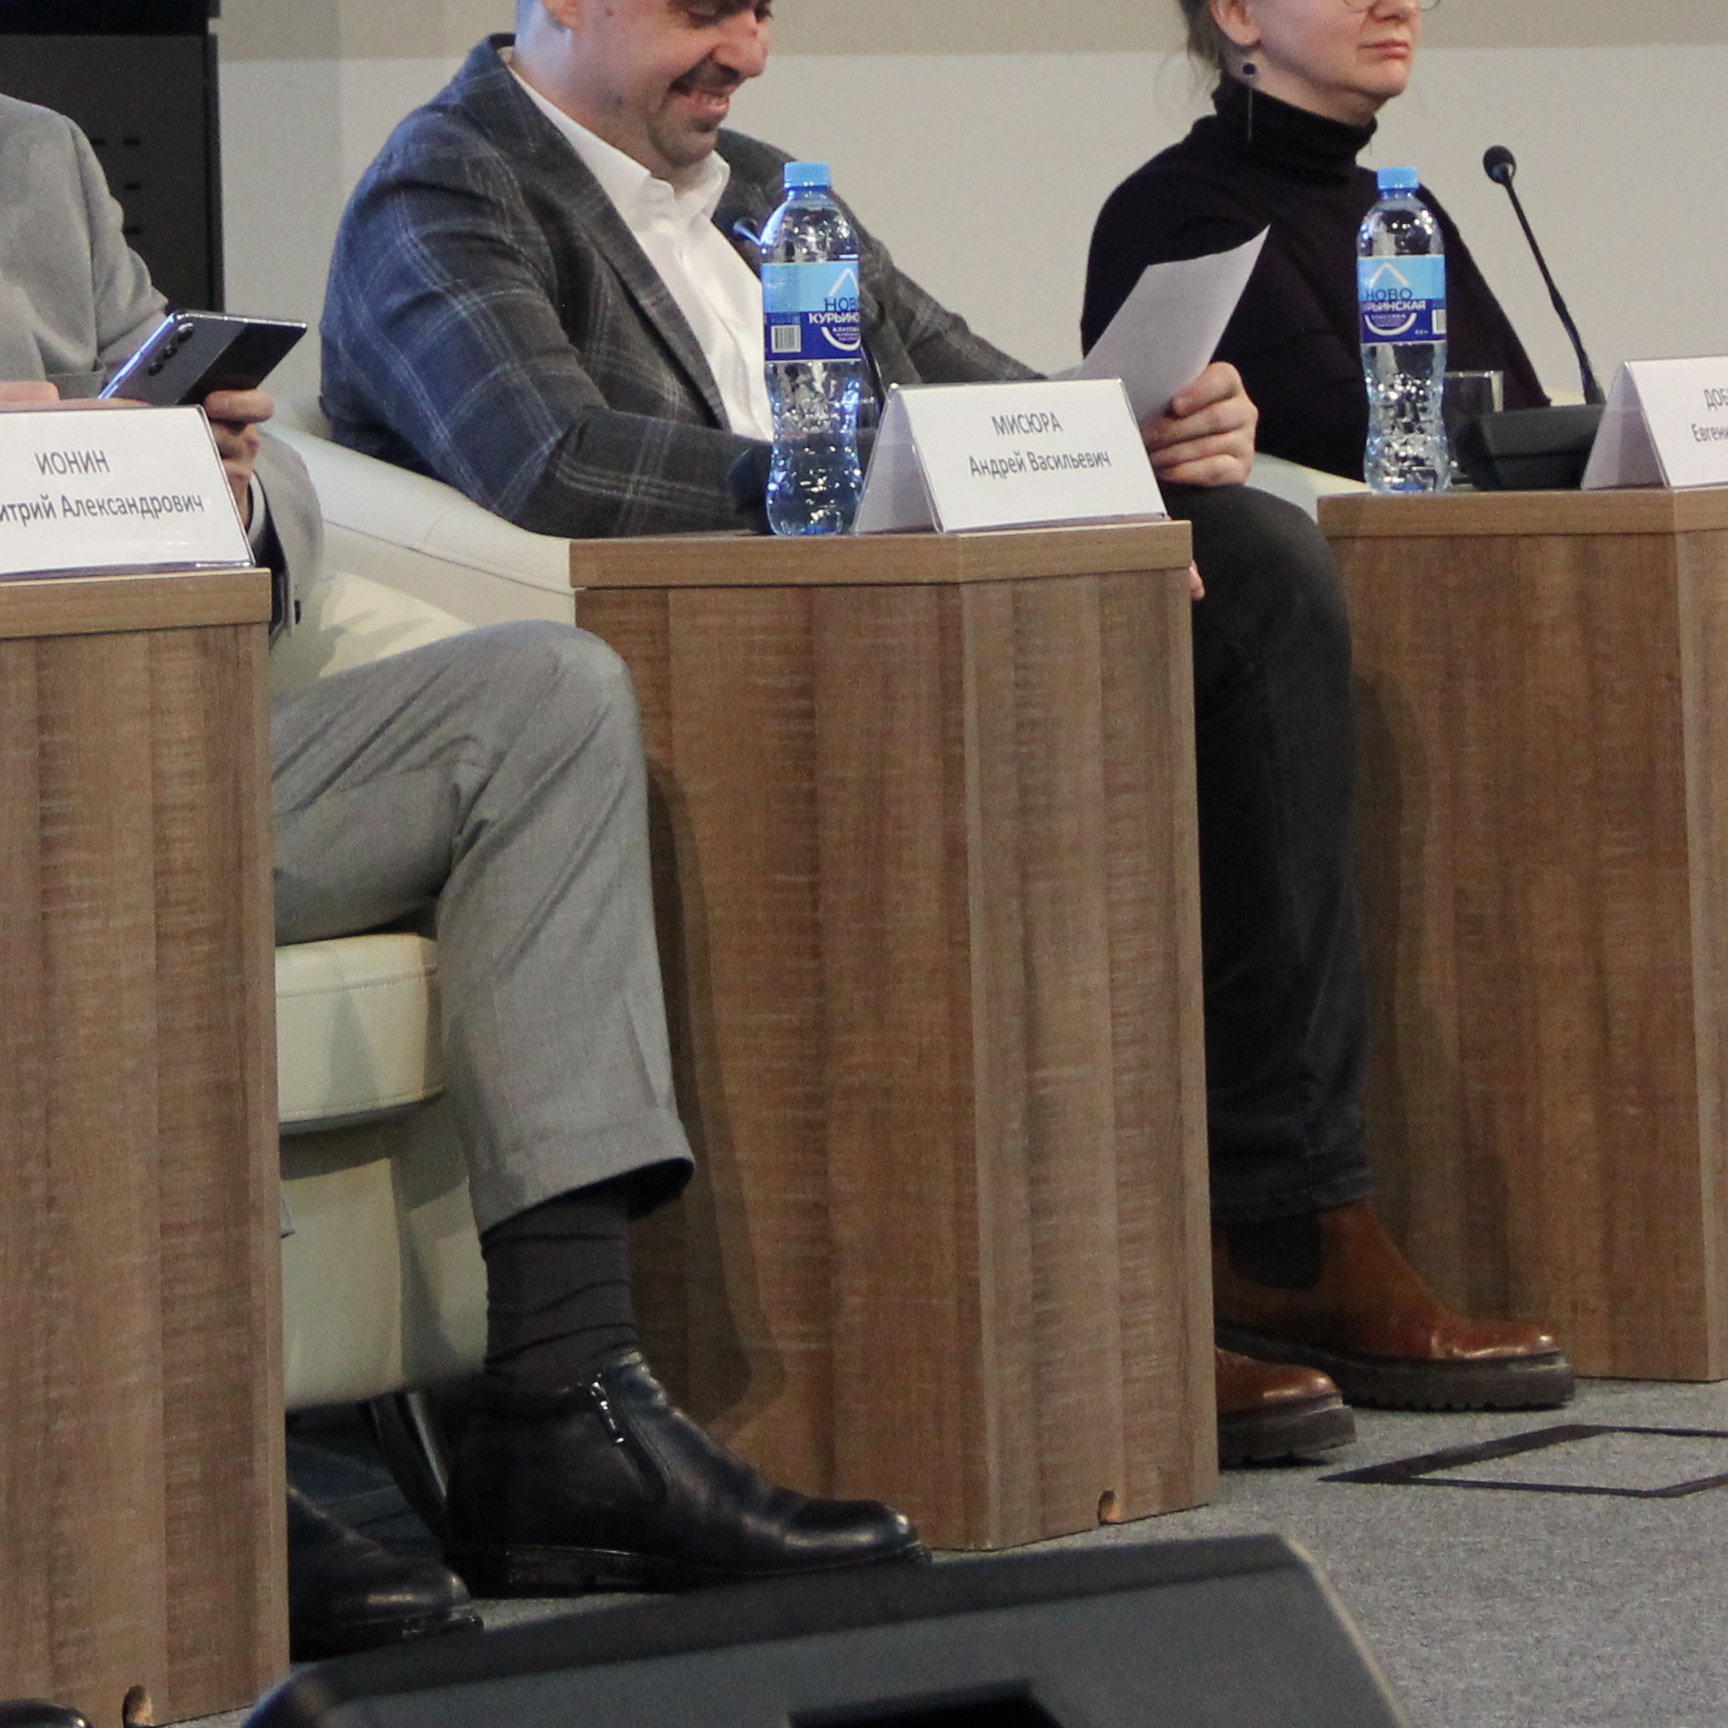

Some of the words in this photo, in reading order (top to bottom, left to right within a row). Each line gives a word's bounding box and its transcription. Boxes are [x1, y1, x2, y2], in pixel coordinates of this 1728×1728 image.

[991, 411, 1064, 436] МИСЮРА
[34, 449, 112, 476] ИОНИН
[968, 450, 1027, 480] Андрей
[1026, 450, 1112, 472] Васильевич
[61, 493, 206, 521] Александрович
